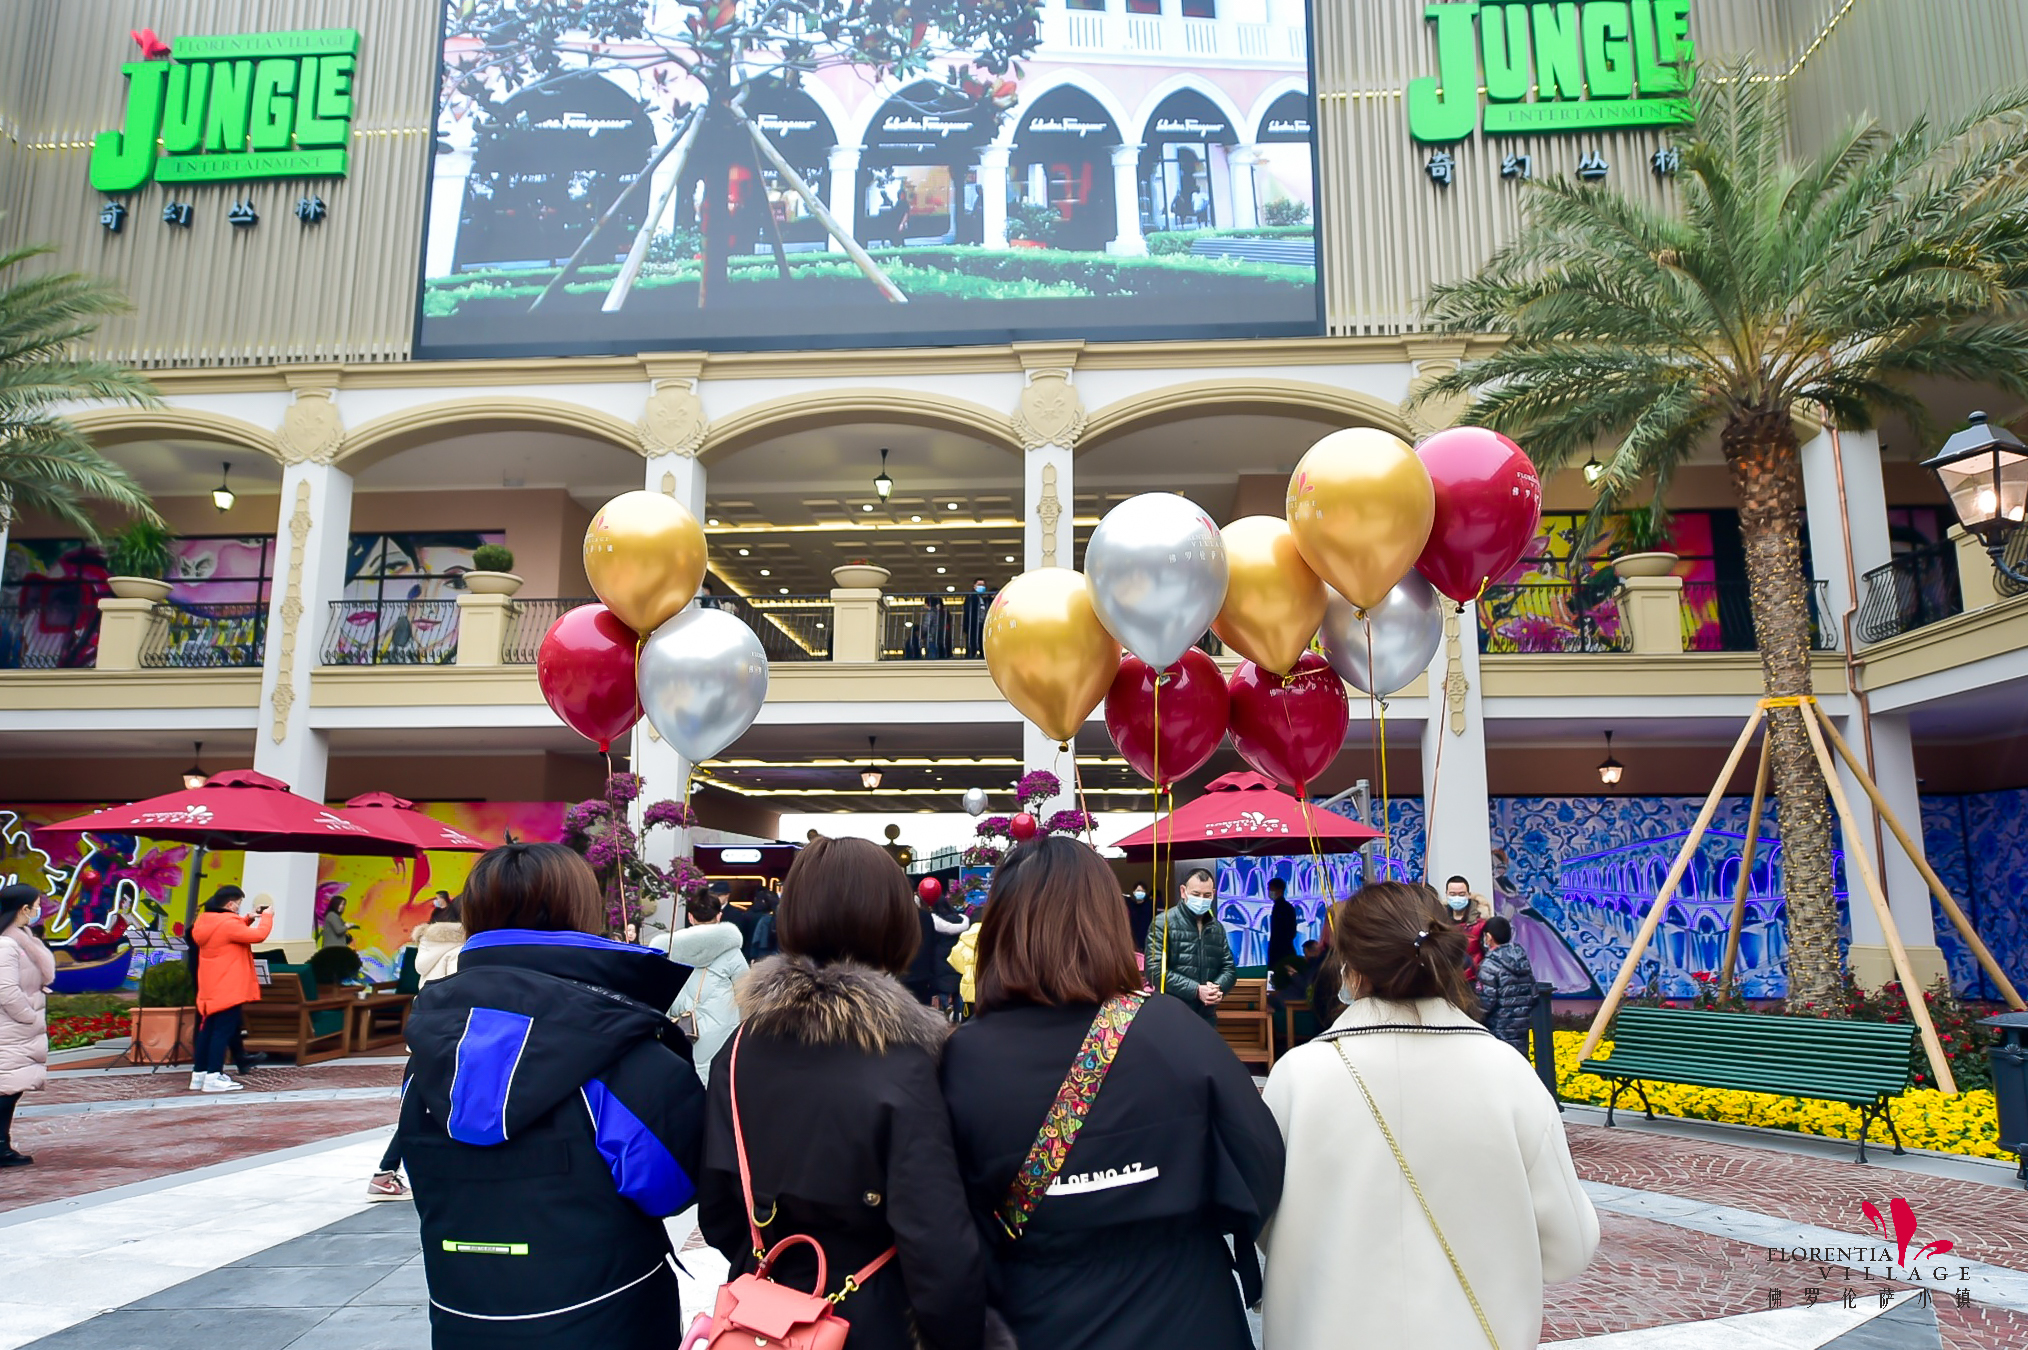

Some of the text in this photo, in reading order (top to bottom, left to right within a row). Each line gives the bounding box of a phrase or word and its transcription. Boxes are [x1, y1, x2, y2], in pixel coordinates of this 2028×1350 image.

[276, 35, 344, 49] VILLAGE
[1409, 0, 1695, 142] JUNGLE
[90, 55, 355, 192] JUNGLE
[176, 157, 322, 173] ENTERTAINMENT
[100, 194, 324, 230] 奇幻丛林
